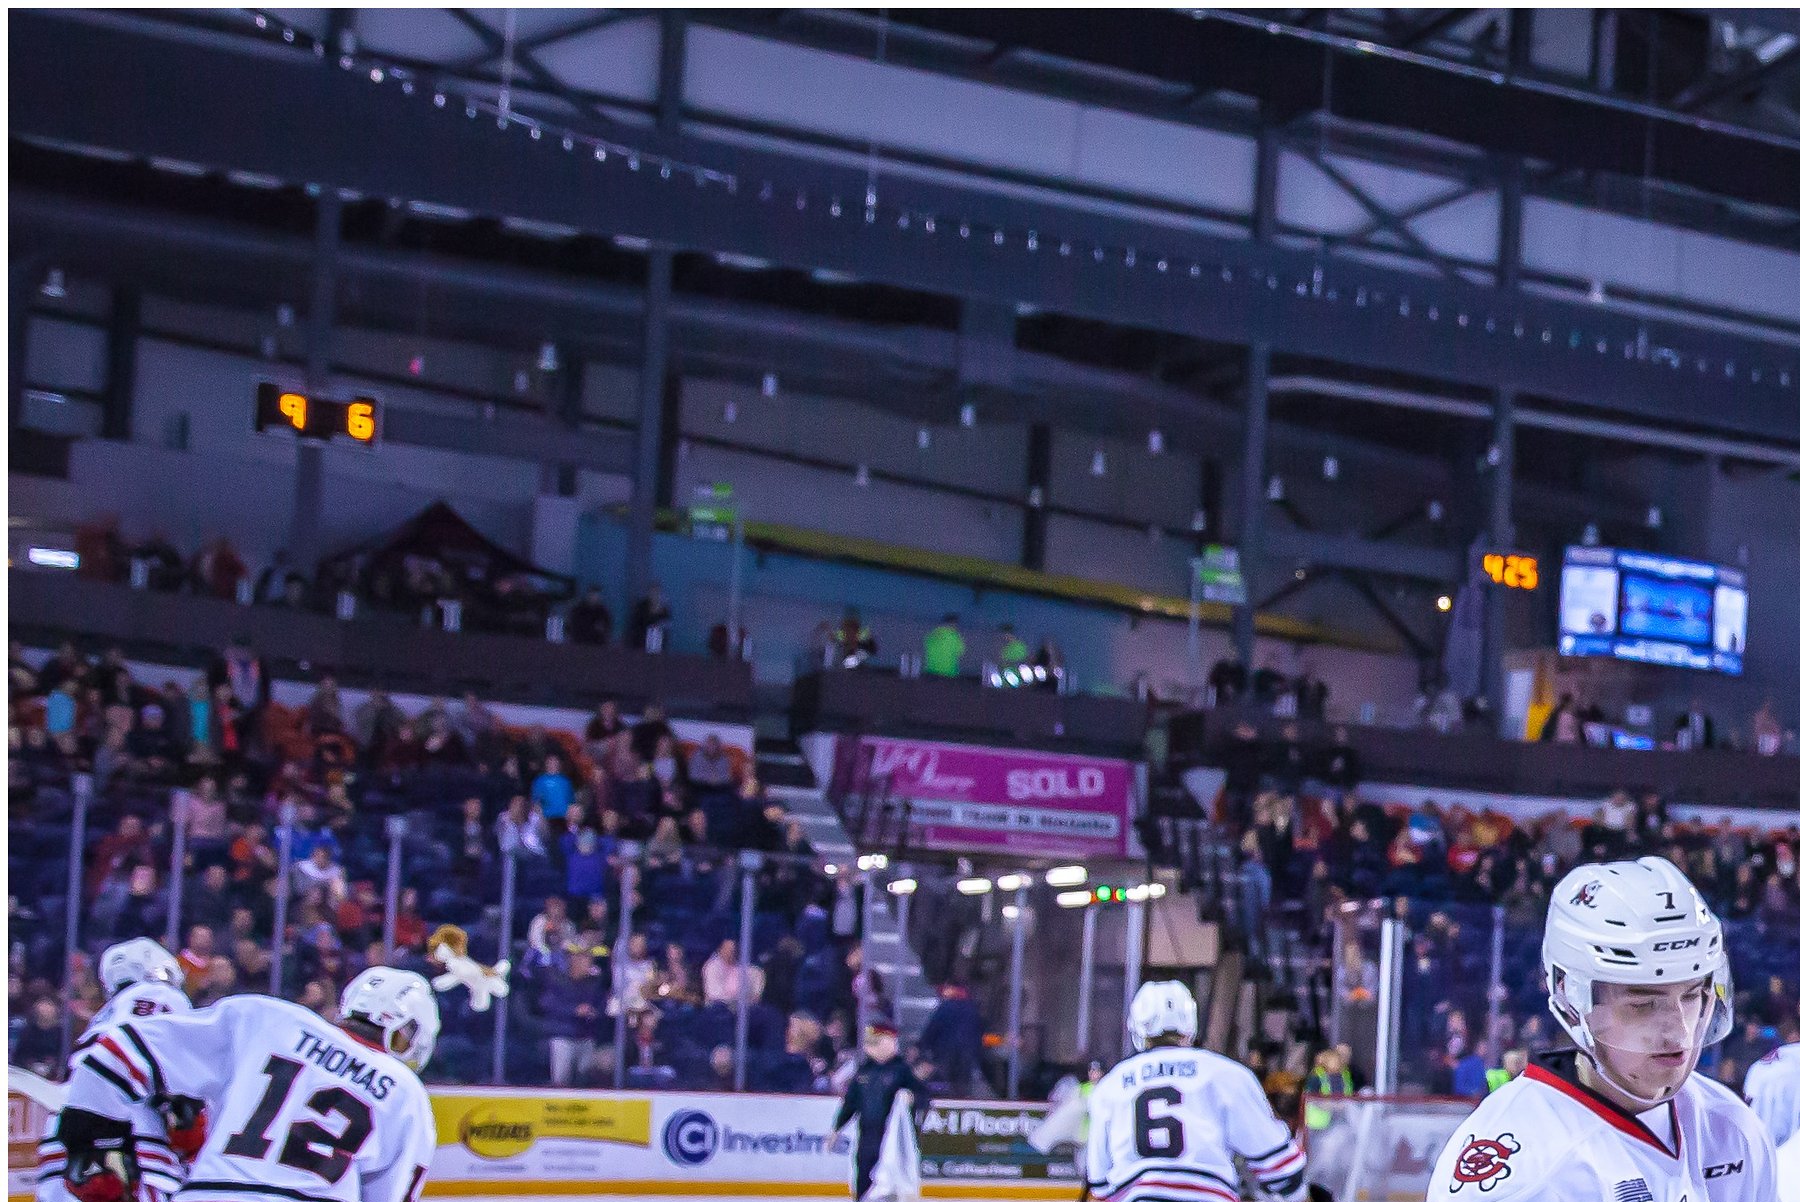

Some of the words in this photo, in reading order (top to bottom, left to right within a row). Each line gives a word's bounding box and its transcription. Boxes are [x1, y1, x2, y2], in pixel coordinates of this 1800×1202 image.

[347, 402, 375, 442] 6
[1006, 767, 1105, 800] SOLD
[1656, 892, 1676, 910] 7
[1652, 936, 1701, 952] CCM
[295, 1030, 397, 1101] THOMAS
[222, 1053, 375, 1185] 12
[1135, 1085, 1185, 1158] 6
[722, 1124, 850, 1154] Investme
[1703, 1159, 1744, 1179] CM
